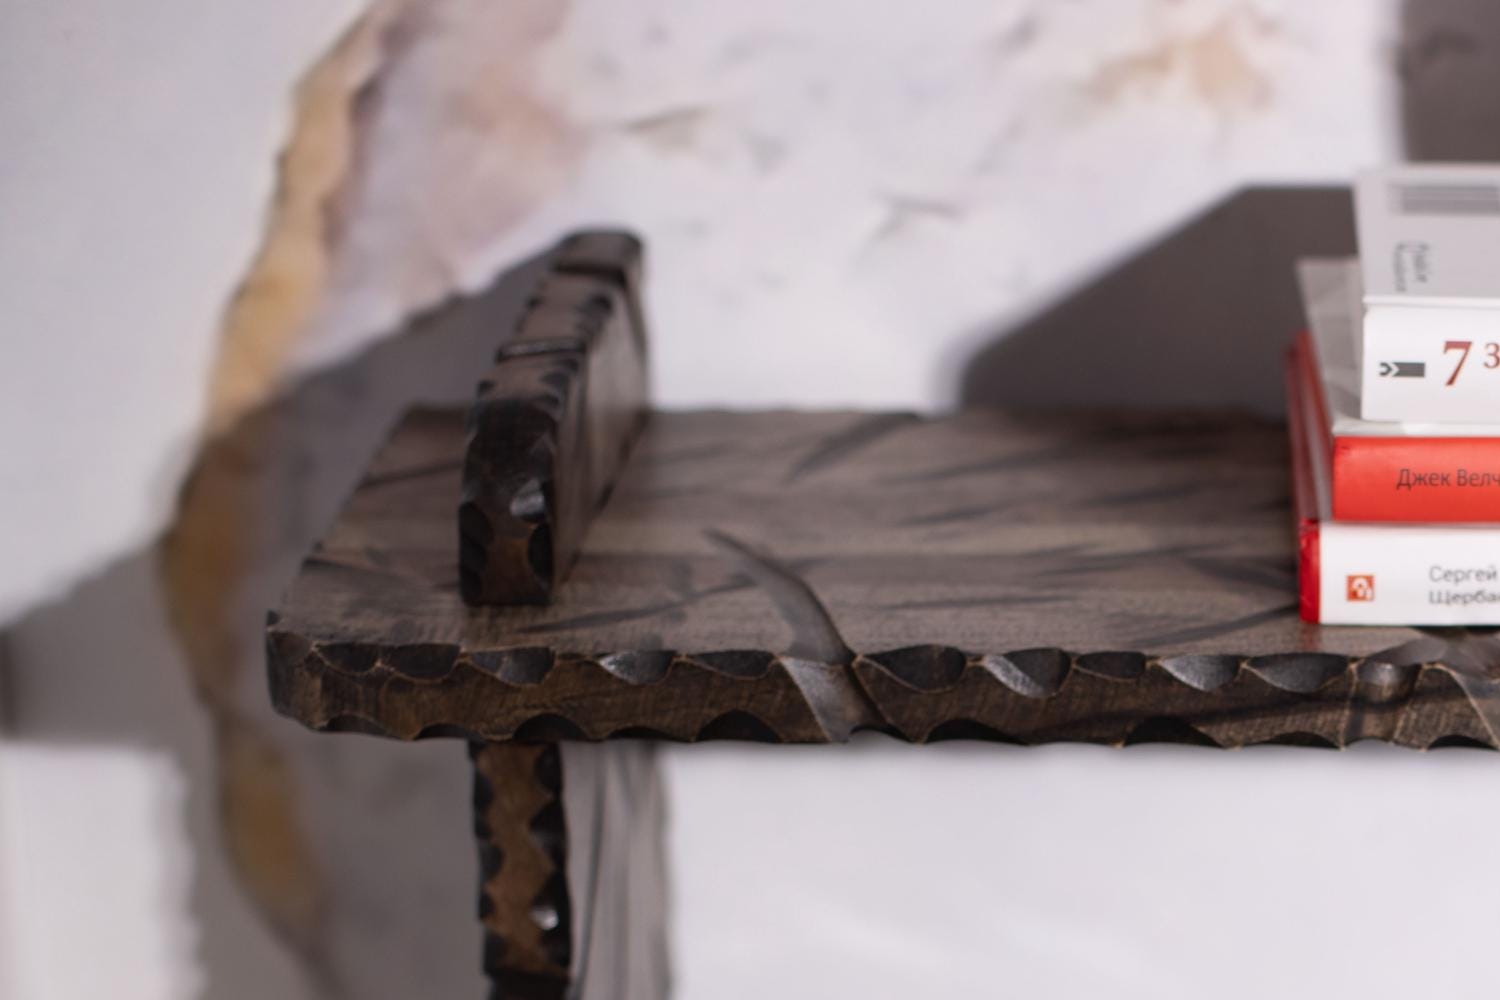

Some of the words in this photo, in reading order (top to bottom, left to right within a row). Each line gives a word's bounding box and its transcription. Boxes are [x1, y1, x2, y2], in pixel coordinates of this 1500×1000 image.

[1441, 339, 1473, 387] 7
[1396, 467, 1452, 491] Джек
[1428, 566, 1498, 584] Сергей
